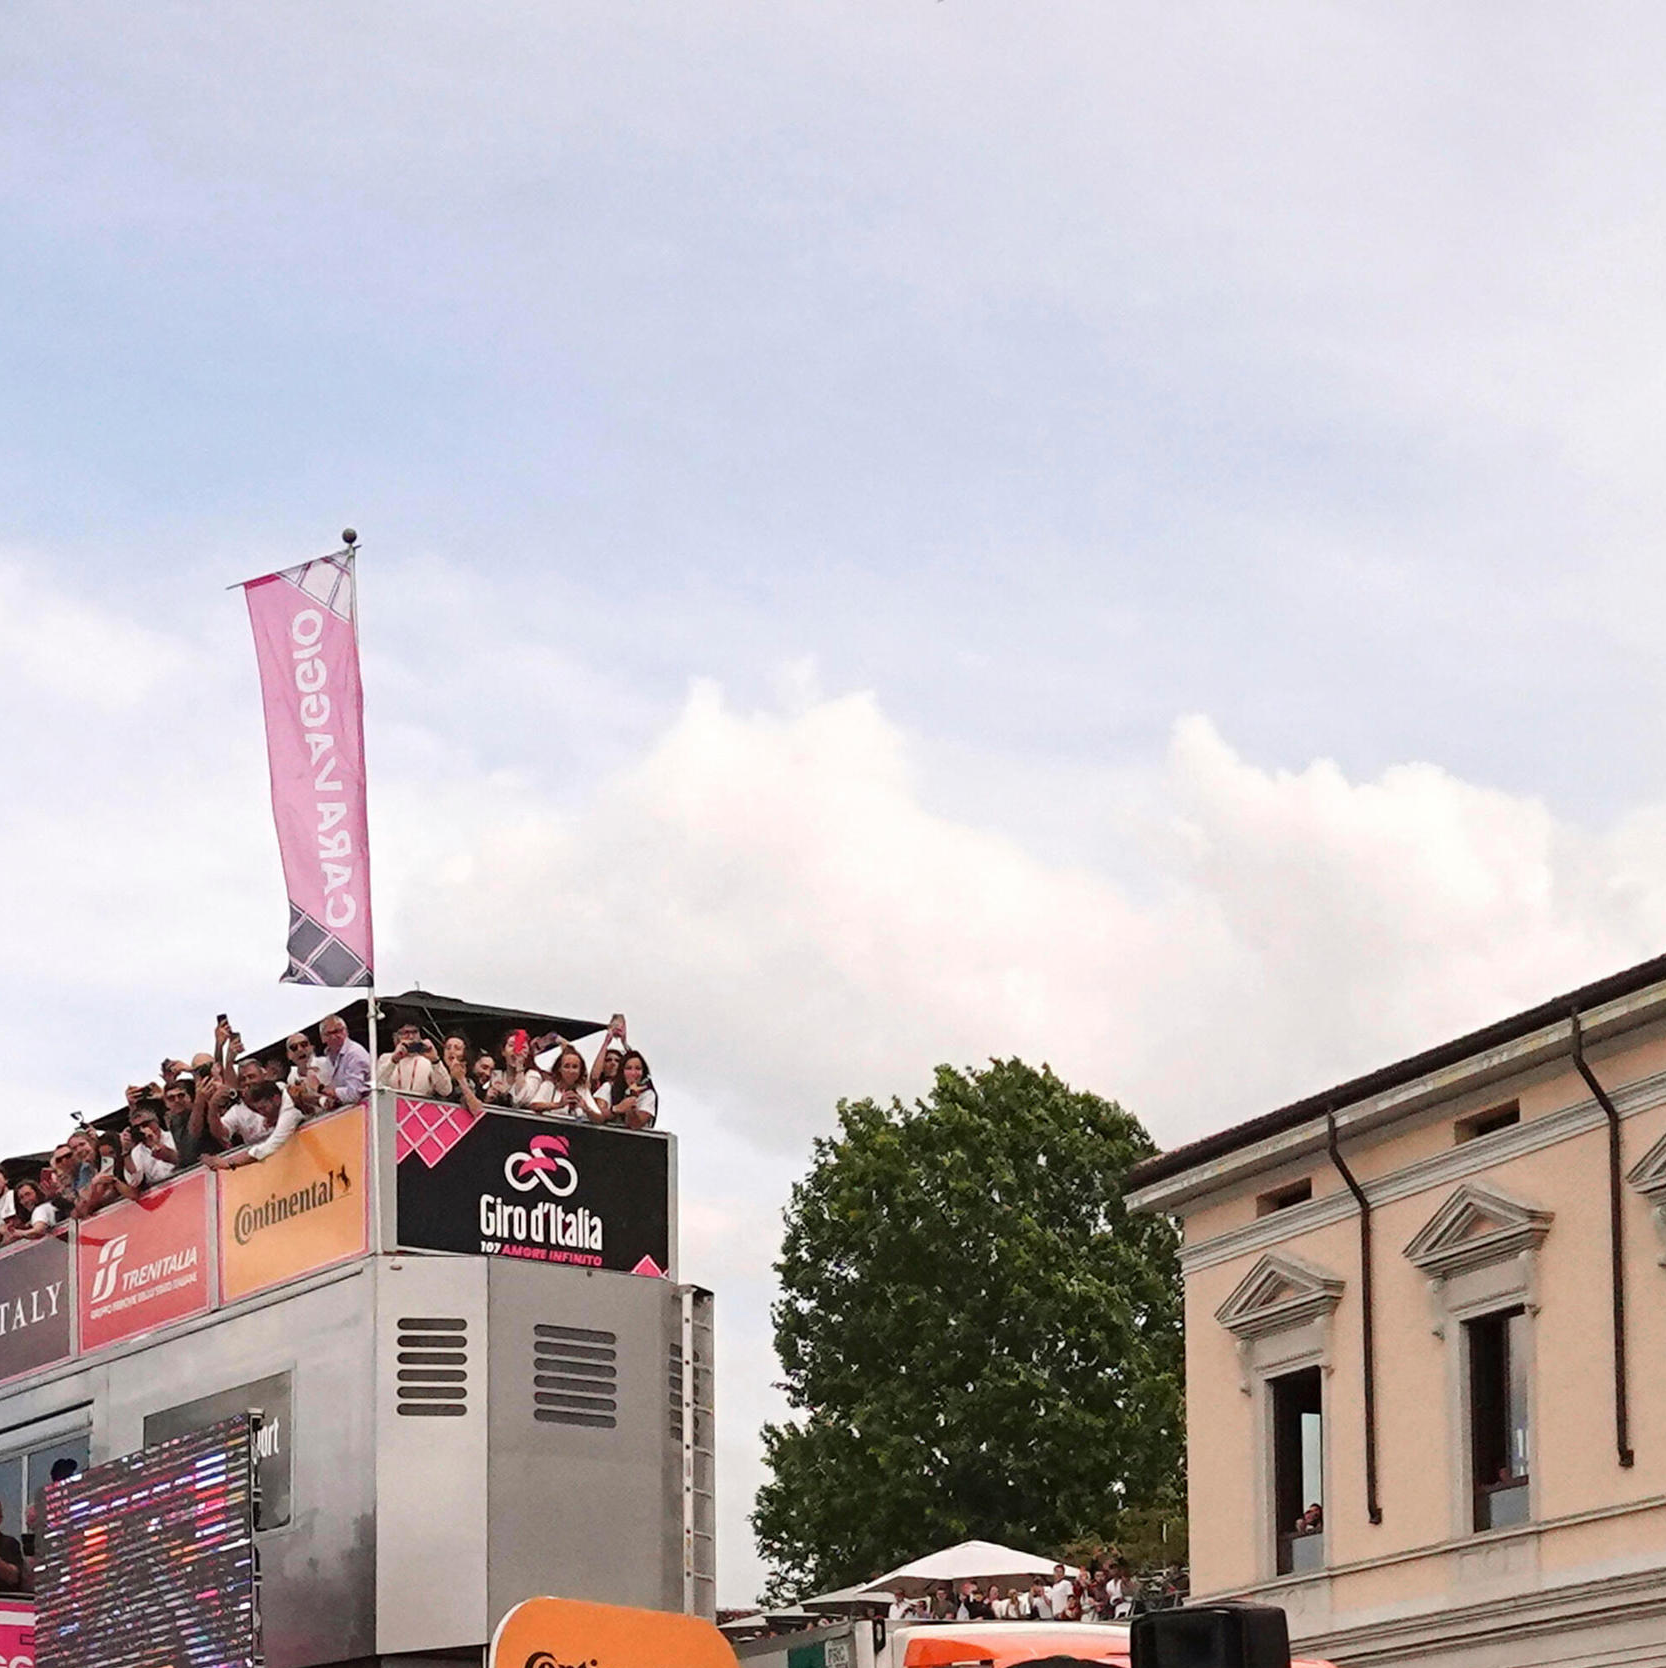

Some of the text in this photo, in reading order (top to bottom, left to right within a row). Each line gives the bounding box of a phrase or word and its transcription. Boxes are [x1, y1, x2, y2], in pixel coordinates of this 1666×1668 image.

[234, 1172, 334, 1246] Continental
[479, 1193, 604, 1250] Giro d'Italia
[121, 1246, 198, 1292] TRENITALIA
[501, 1244, 547, 1260] AMORE
[548, 1250, 603, 1267] INFINITO
